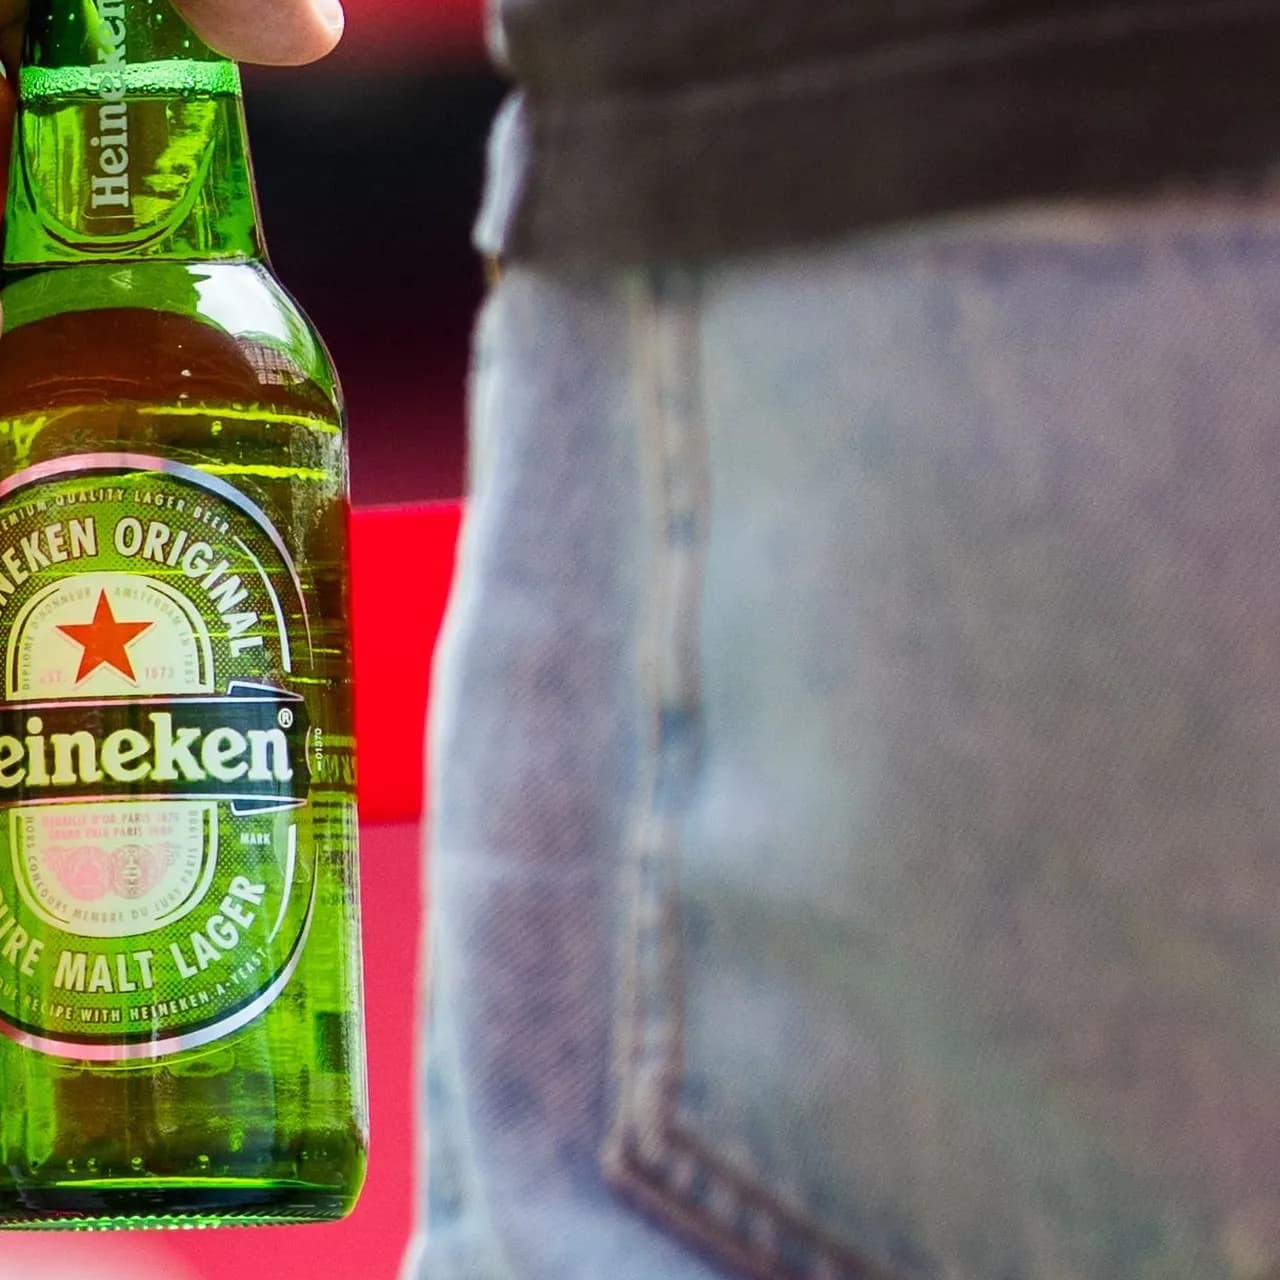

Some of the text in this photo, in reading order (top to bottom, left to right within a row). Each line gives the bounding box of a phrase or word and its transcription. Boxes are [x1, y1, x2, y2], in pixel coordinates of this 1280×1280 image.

[55, 487, 125, 506] QUALITY
[134, 490, 186, 513] LAGER
[193, 505, 230, 535] BEER
[114, 516, 264, 658] ORIGINAL
[240, 832, 272, 847] MARK
[54, 950, 154, 993] MALT
[169, 874, 268, 979] LAGER
[24, 994, 74, 1020] RECIPE
[80, 1008, 121, 1022] WITH
[129, 991, 209, 1021] HEINEKEN
